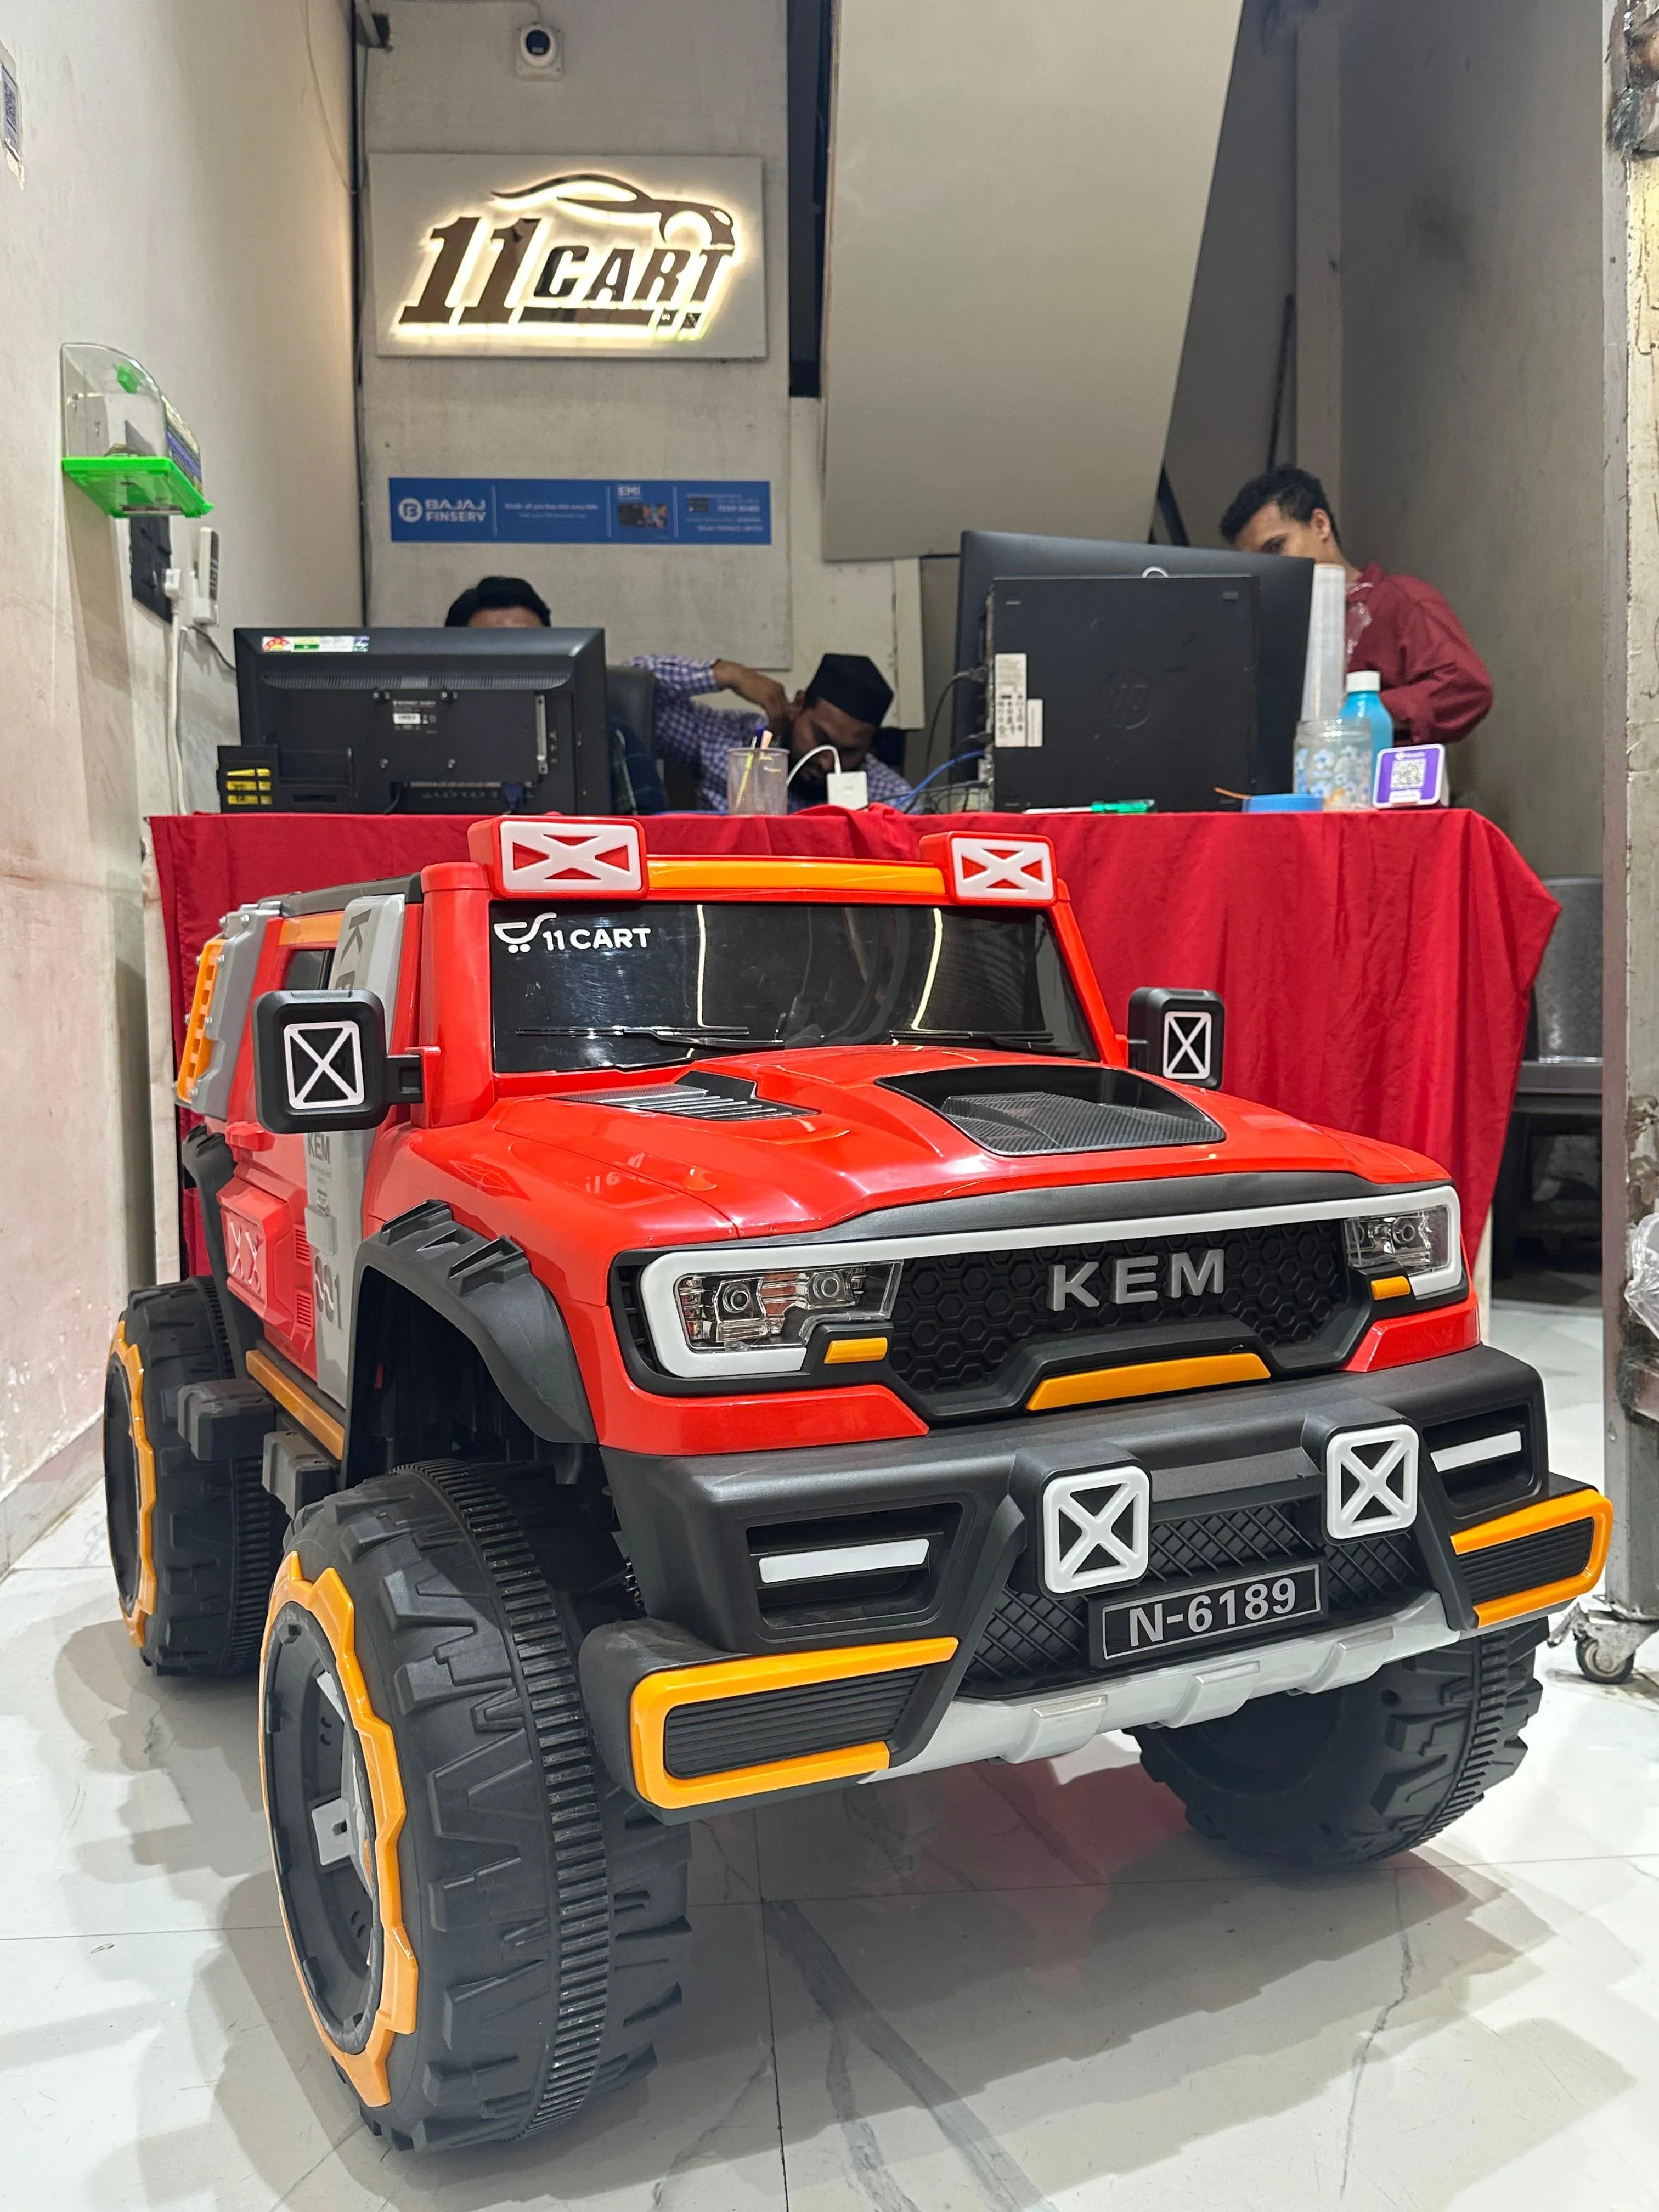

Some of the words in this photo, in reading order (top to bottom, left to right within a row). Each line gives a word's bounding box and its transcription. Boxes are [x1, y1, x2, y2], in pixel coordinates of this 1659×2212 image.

[399, 217, 542, 325] 11
[534, 245, 732, 302] CART
[425, 499, 486, 510] BAJAJ
[425, 511, 486, 522] FINSERV
[543, 929, 566, 951] 11
[570, 928, 651, 950] CART
[307, 1132, 331, 1164] KEM
[1048, 1249, 1224, 1311] KEM
[1129, 1577, 1296, 1647] N-6189
